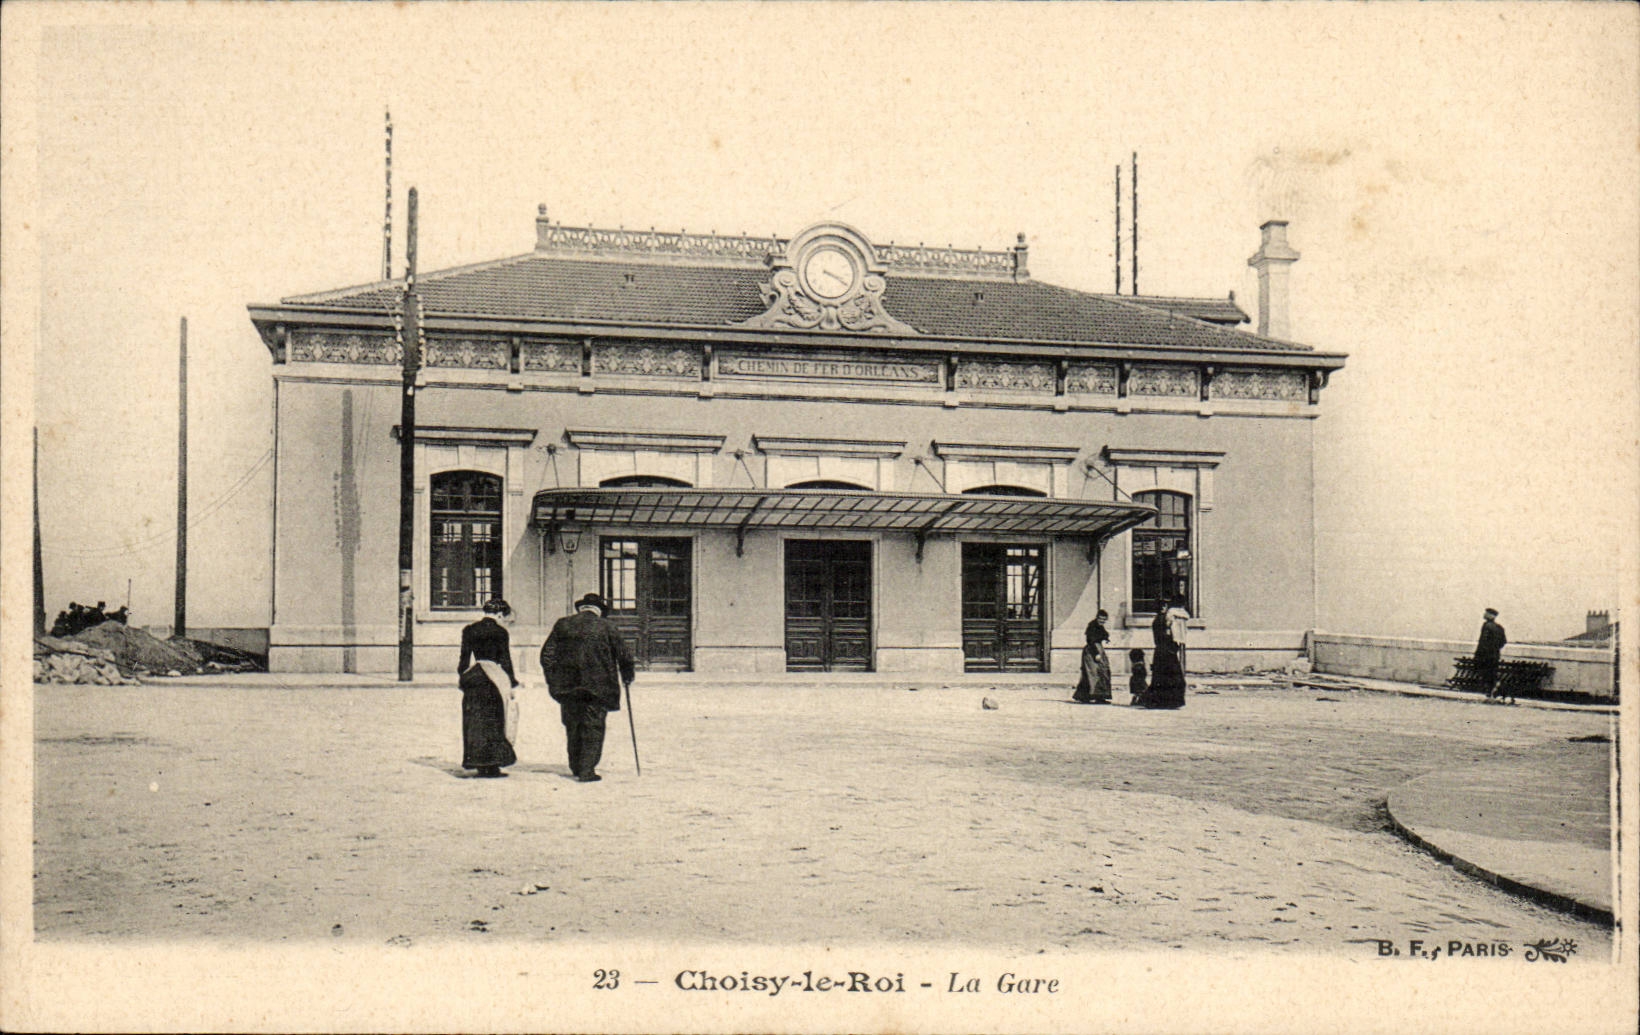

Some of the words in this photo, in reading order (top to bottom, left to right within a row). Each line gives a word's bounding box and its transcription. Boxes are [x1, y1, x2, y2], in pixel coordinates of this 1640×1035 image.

[738, 359, 789, 374] CHEMIN
[793, 361, 809, 375] DE
[813, 362, 838, 376] FER
